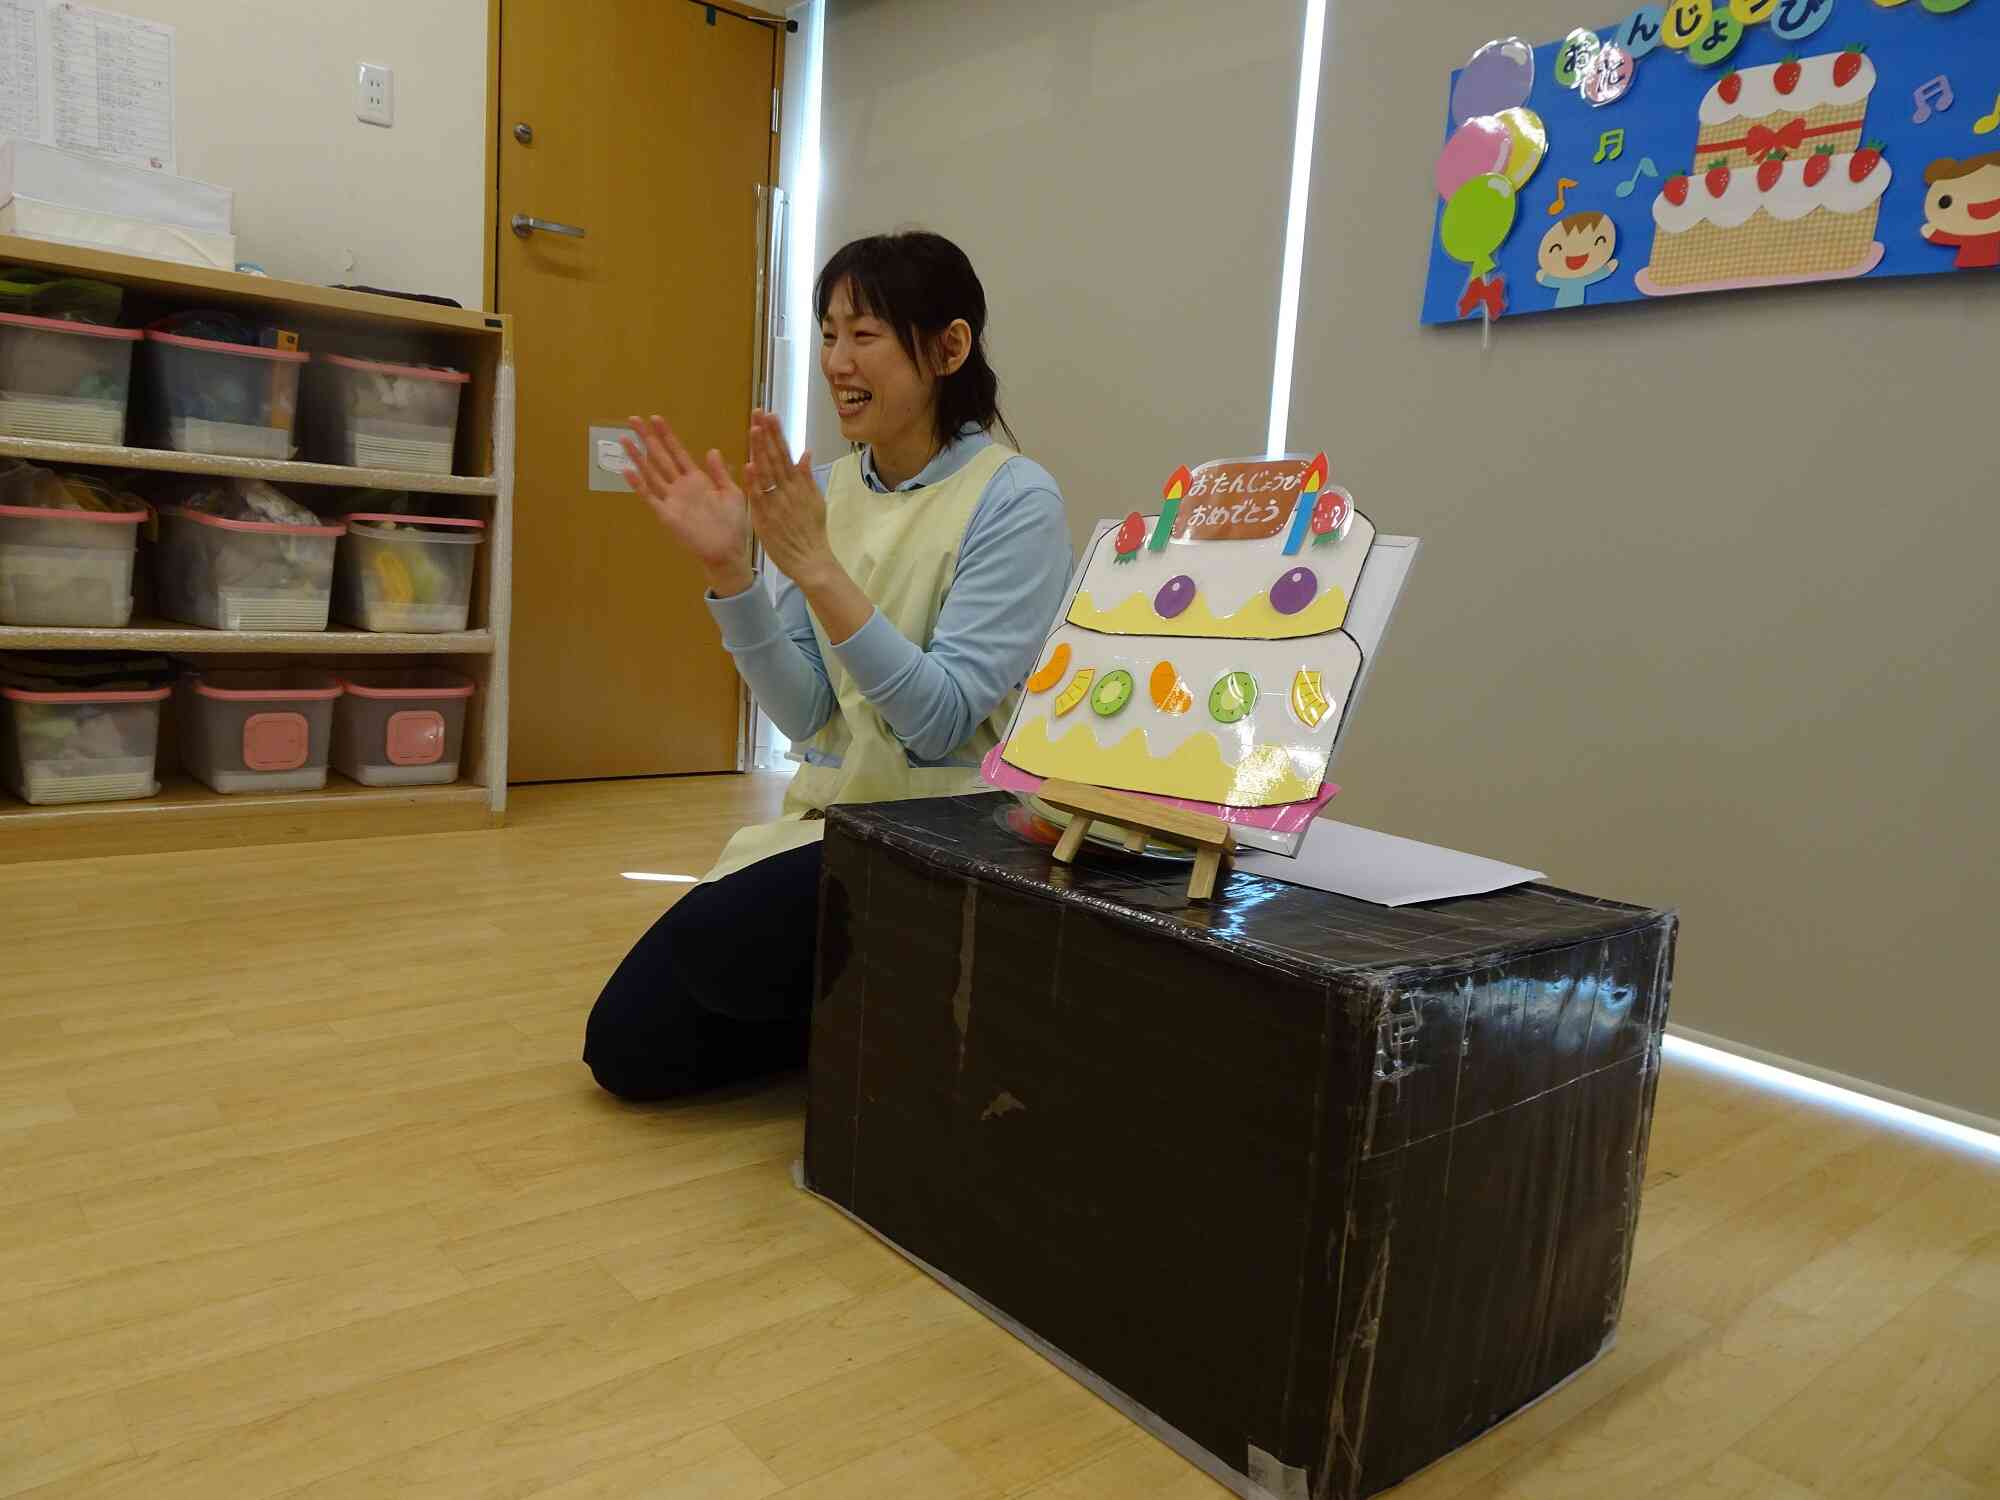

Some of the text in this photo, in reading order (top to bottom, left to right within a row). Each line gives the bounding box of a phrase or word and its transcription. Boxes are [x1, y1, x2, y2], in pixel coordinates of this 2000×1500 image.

[1188, 470, 1306, 496] おたんじょうび
[1187, 498, 1280, 527] おめでとう
